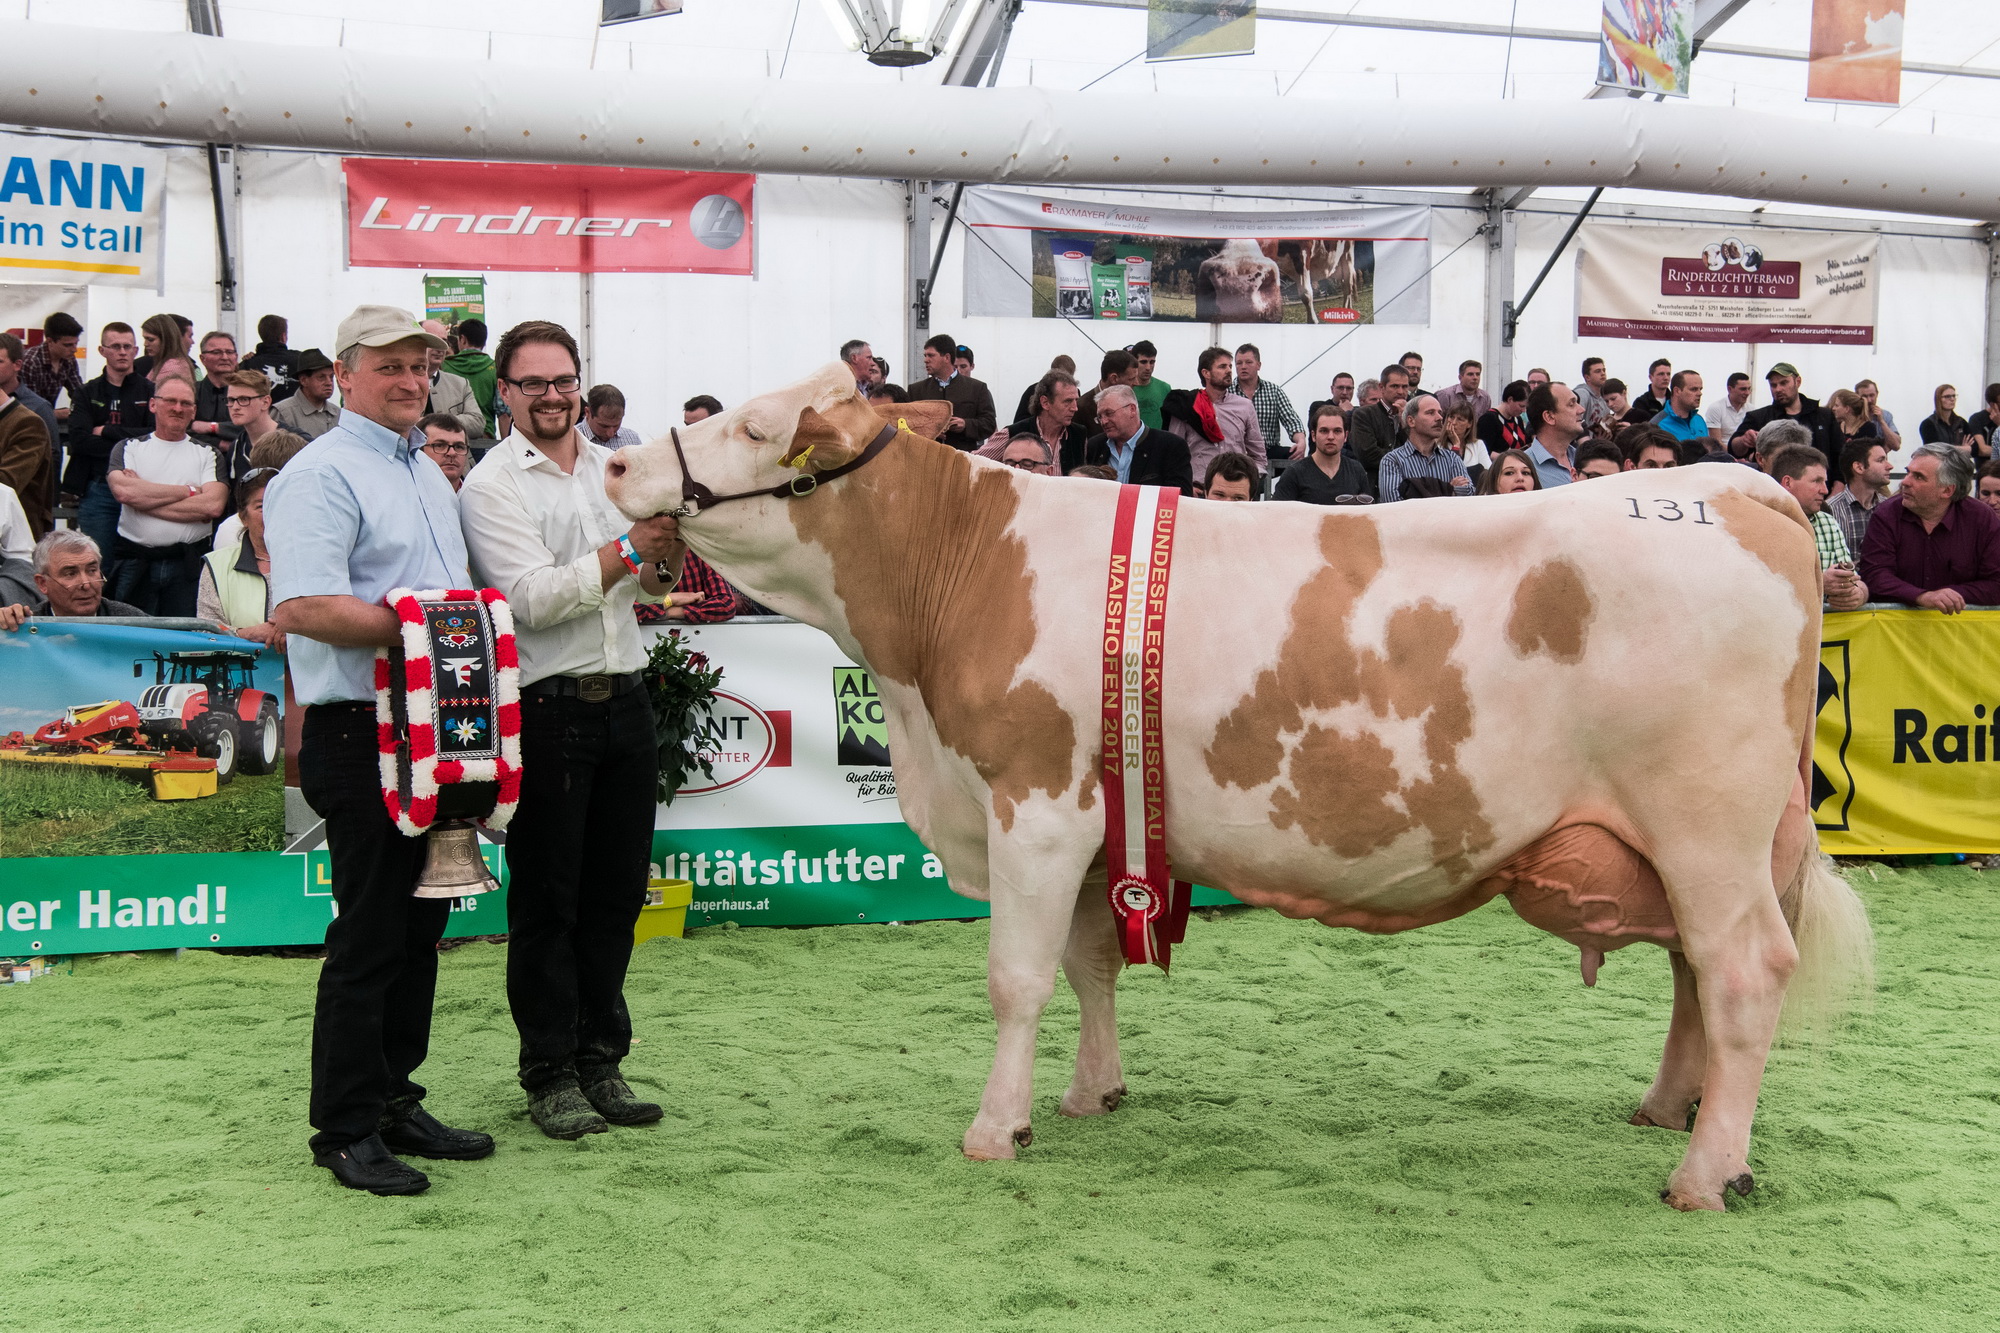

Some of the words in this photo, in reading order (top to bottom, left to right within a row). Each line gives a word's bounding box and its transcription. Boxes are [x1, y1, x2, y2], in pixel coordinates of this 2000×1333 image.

[0, 156, 145, 213] ANN
[0, 216, 43, 247] im
[60, 220, 143, 254] Stall
[359, 197, 673, 237] Lindner
[1668, 269, 1795, 285] RINDERZUCHTVERBAND
[1841, 254, 1870, 268] machen
[1323, 311, 1355, 320] Milkivit
[1770, 327, 1866, 336] www.rinderzuchtverband.at
[1625, 497, 1715, 525] 131
[1103, 554, 1127, 709] MAISHOFEN
[1124, 562, 1147, 770] BUNDESSIEGER
[1144, 508, 1174, 840] BUNDESFLECKVIEHSCHAU
[1103, 718, 1119, 776] 2017
[857, 783, 876, 798] für
[877, 783, 898, 796] Bio
[0, 899, 61, 932] er
[79, 883, 227, 930] Hand!
